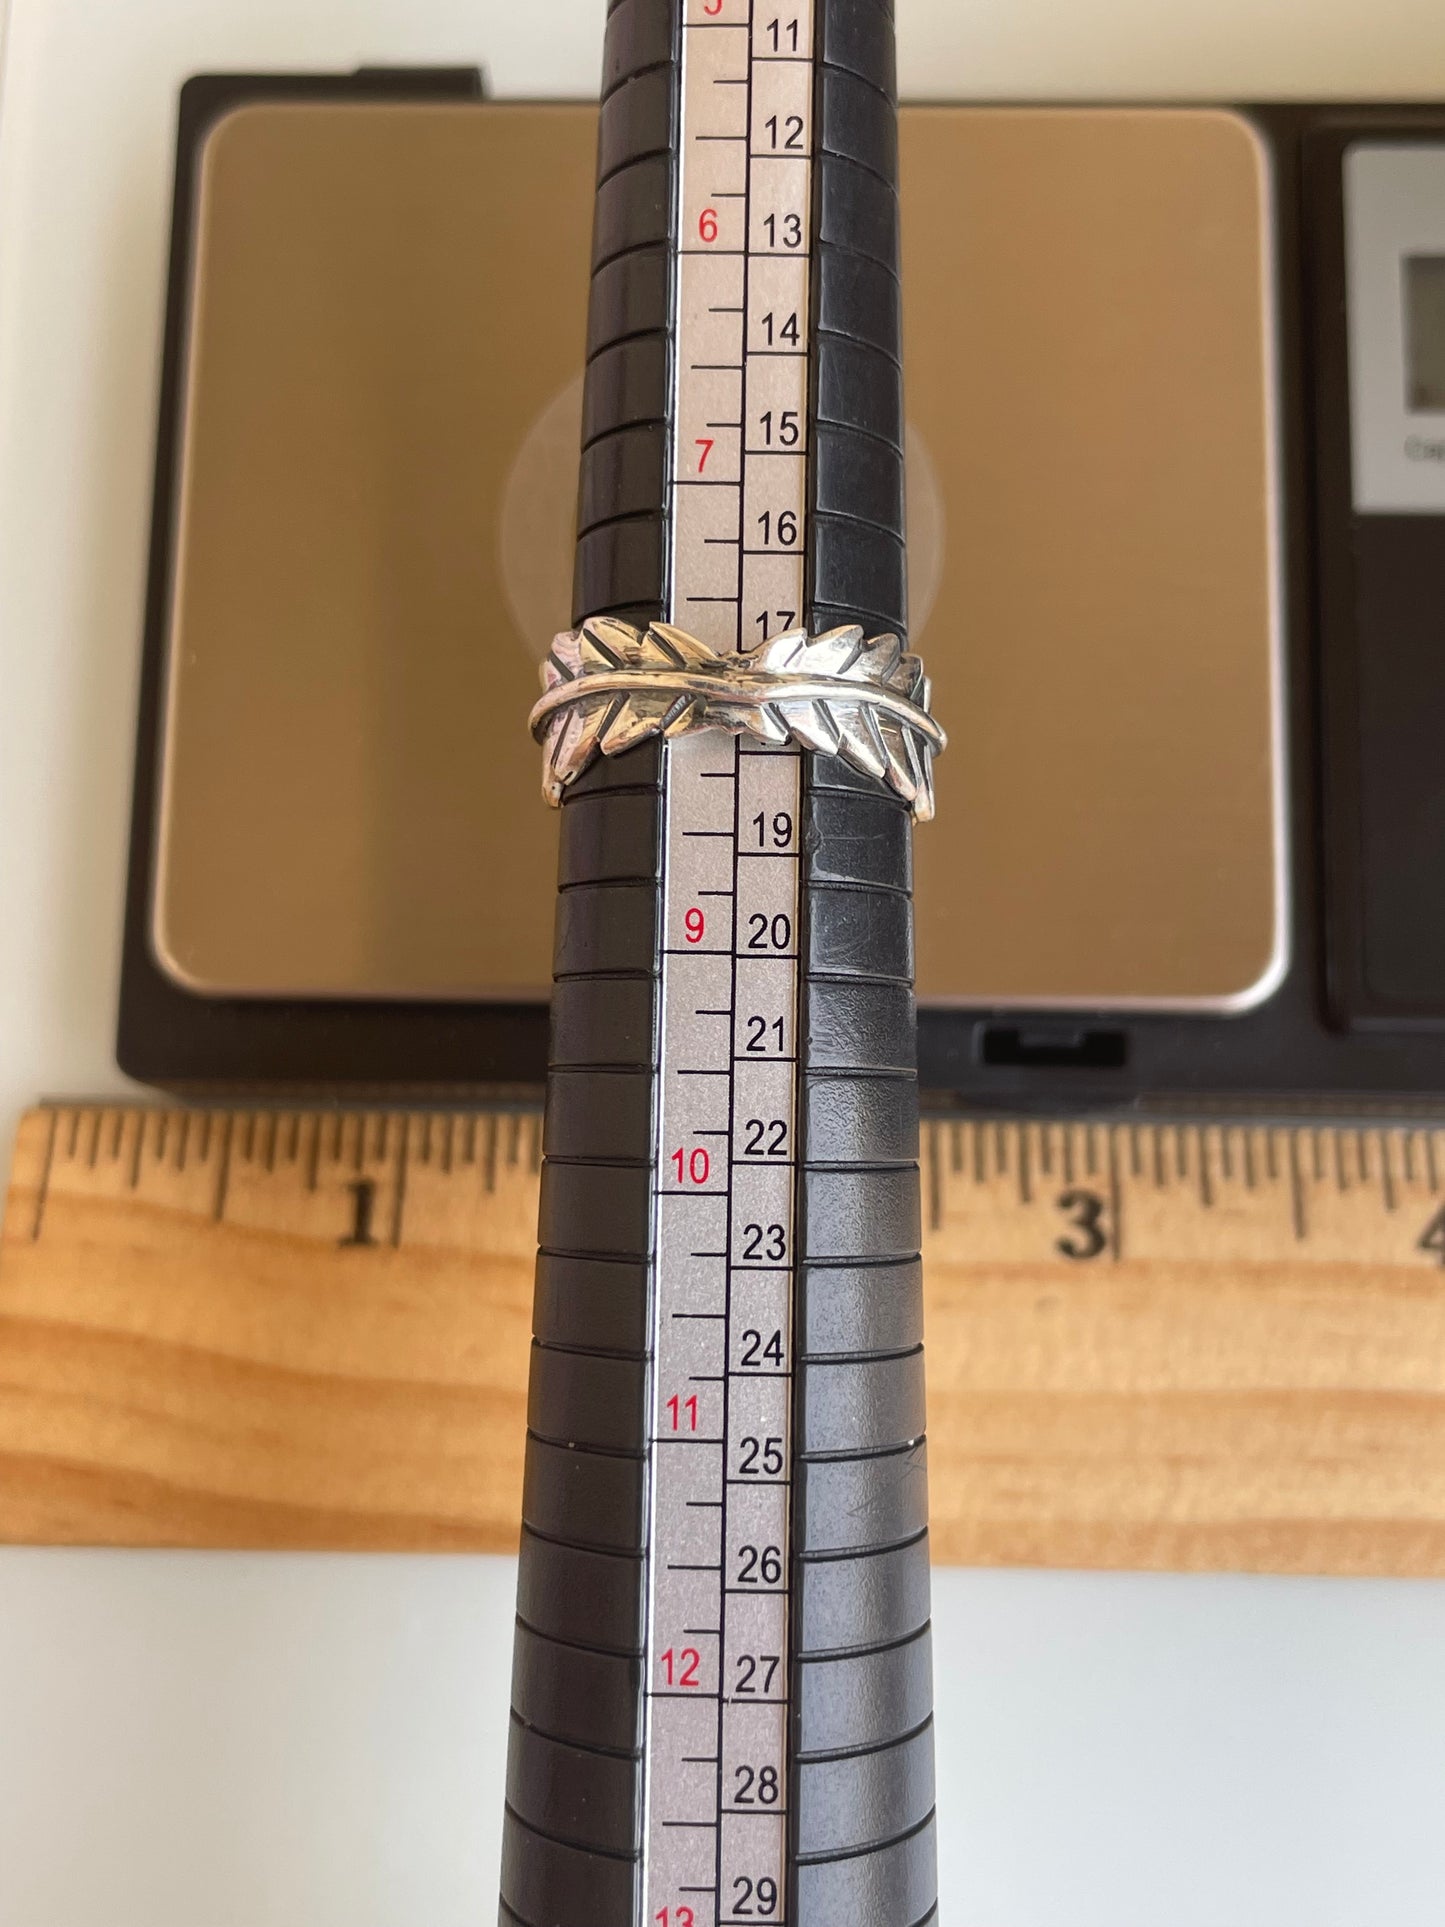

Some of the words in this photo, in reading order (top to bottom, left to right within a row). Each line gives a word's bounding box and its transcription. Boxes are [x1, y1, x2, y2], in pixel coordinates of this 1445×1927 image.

[766, 18, 799, 52] 11
[764, 115, 804, 150] 12
[698, 208, 719, 243] 6
[763, 213, 801, 249] 13
[761, 312, 801, 347] 14
[758, 411, 799, 446] 15
[695, 438, 715, 474] 7
[757, 510, 798, 546] 16
[756, 610, 796, 641] 17
[752, 811, 793, 848] 19
[684, 907, 705, 944] 9
[747, 913, 791, 950] 20
[746, 1015, 784, 1053] 21
[743, 1118, 788, 1156] 22
[671, 1147, 711, 1185] 10
[337, 1177, 380, 1248] 1
[1055, 1189, 1107, 1260] 3
[742, 1223, 787, 1262] 23
[740, 1329, 785, 1367] 24
[666, 1394, 698, 1432] 11
[738, 1436, 784, 1475] 25
[737, 1545, 782, 1584] 26
[660, 1648, 701, 1687] 12
[735, 1654, 780, 1694] 27
[733, 1764, 779, 1805] 28
[732, 1876, 778, 1916] 29
